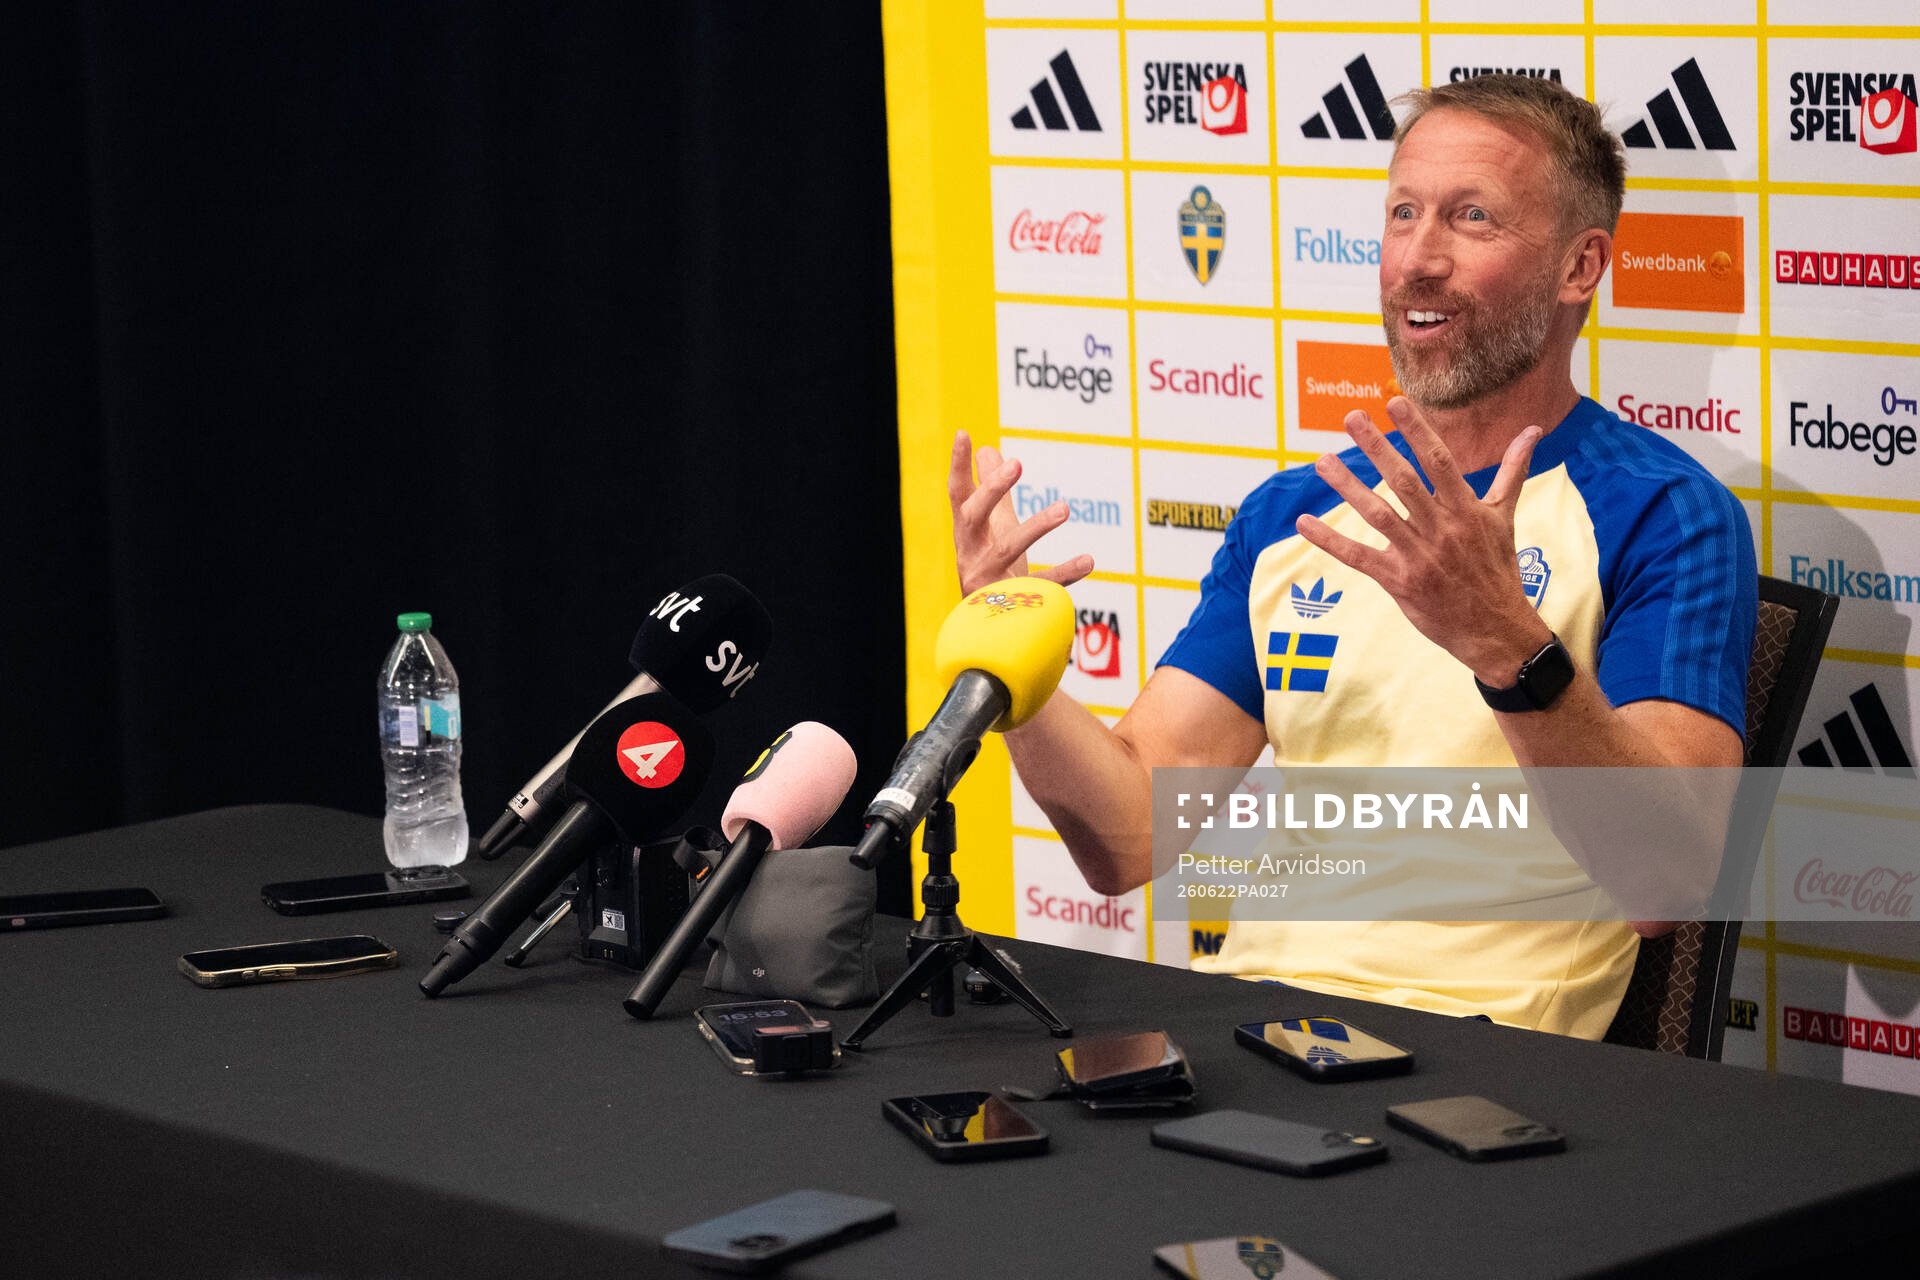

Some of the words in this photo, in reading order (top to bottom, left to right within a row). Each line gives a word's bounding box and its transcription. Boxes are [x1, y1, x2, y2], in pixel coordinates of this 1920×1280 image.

[1144, 62, 1247, 93] SVENSKA
[1790, 72, 1919, 107] SVENSKA
[1145, 95, 1197, 124] SPEL
[1790, 108, 1856, 142] SPEL
[1294, 226, 1381, 265] Folksa
[1621, 251, 1706, 273] Swedbank
[1014, 348, 1113, 403] Fabege
[1149, 359, 1264, 399] Scandic
[1306, 377, 1382, 399] Swedbank
[1617, 395, 1741, 434] Scandic
[1790, 402, 1918, 466] Fabege
[1789, 555, 1920, 604] Folksam
[649, 591, 704, 633] svt
[705, 640, 760, 699] svt
[621, 739, 679, 781] 4
[1793, 857, 1920, 917] Coca-Cola
[1026, 886, 1135, 932] Scandic
[1786, 1009, 1920, 1055] BAUHAU
